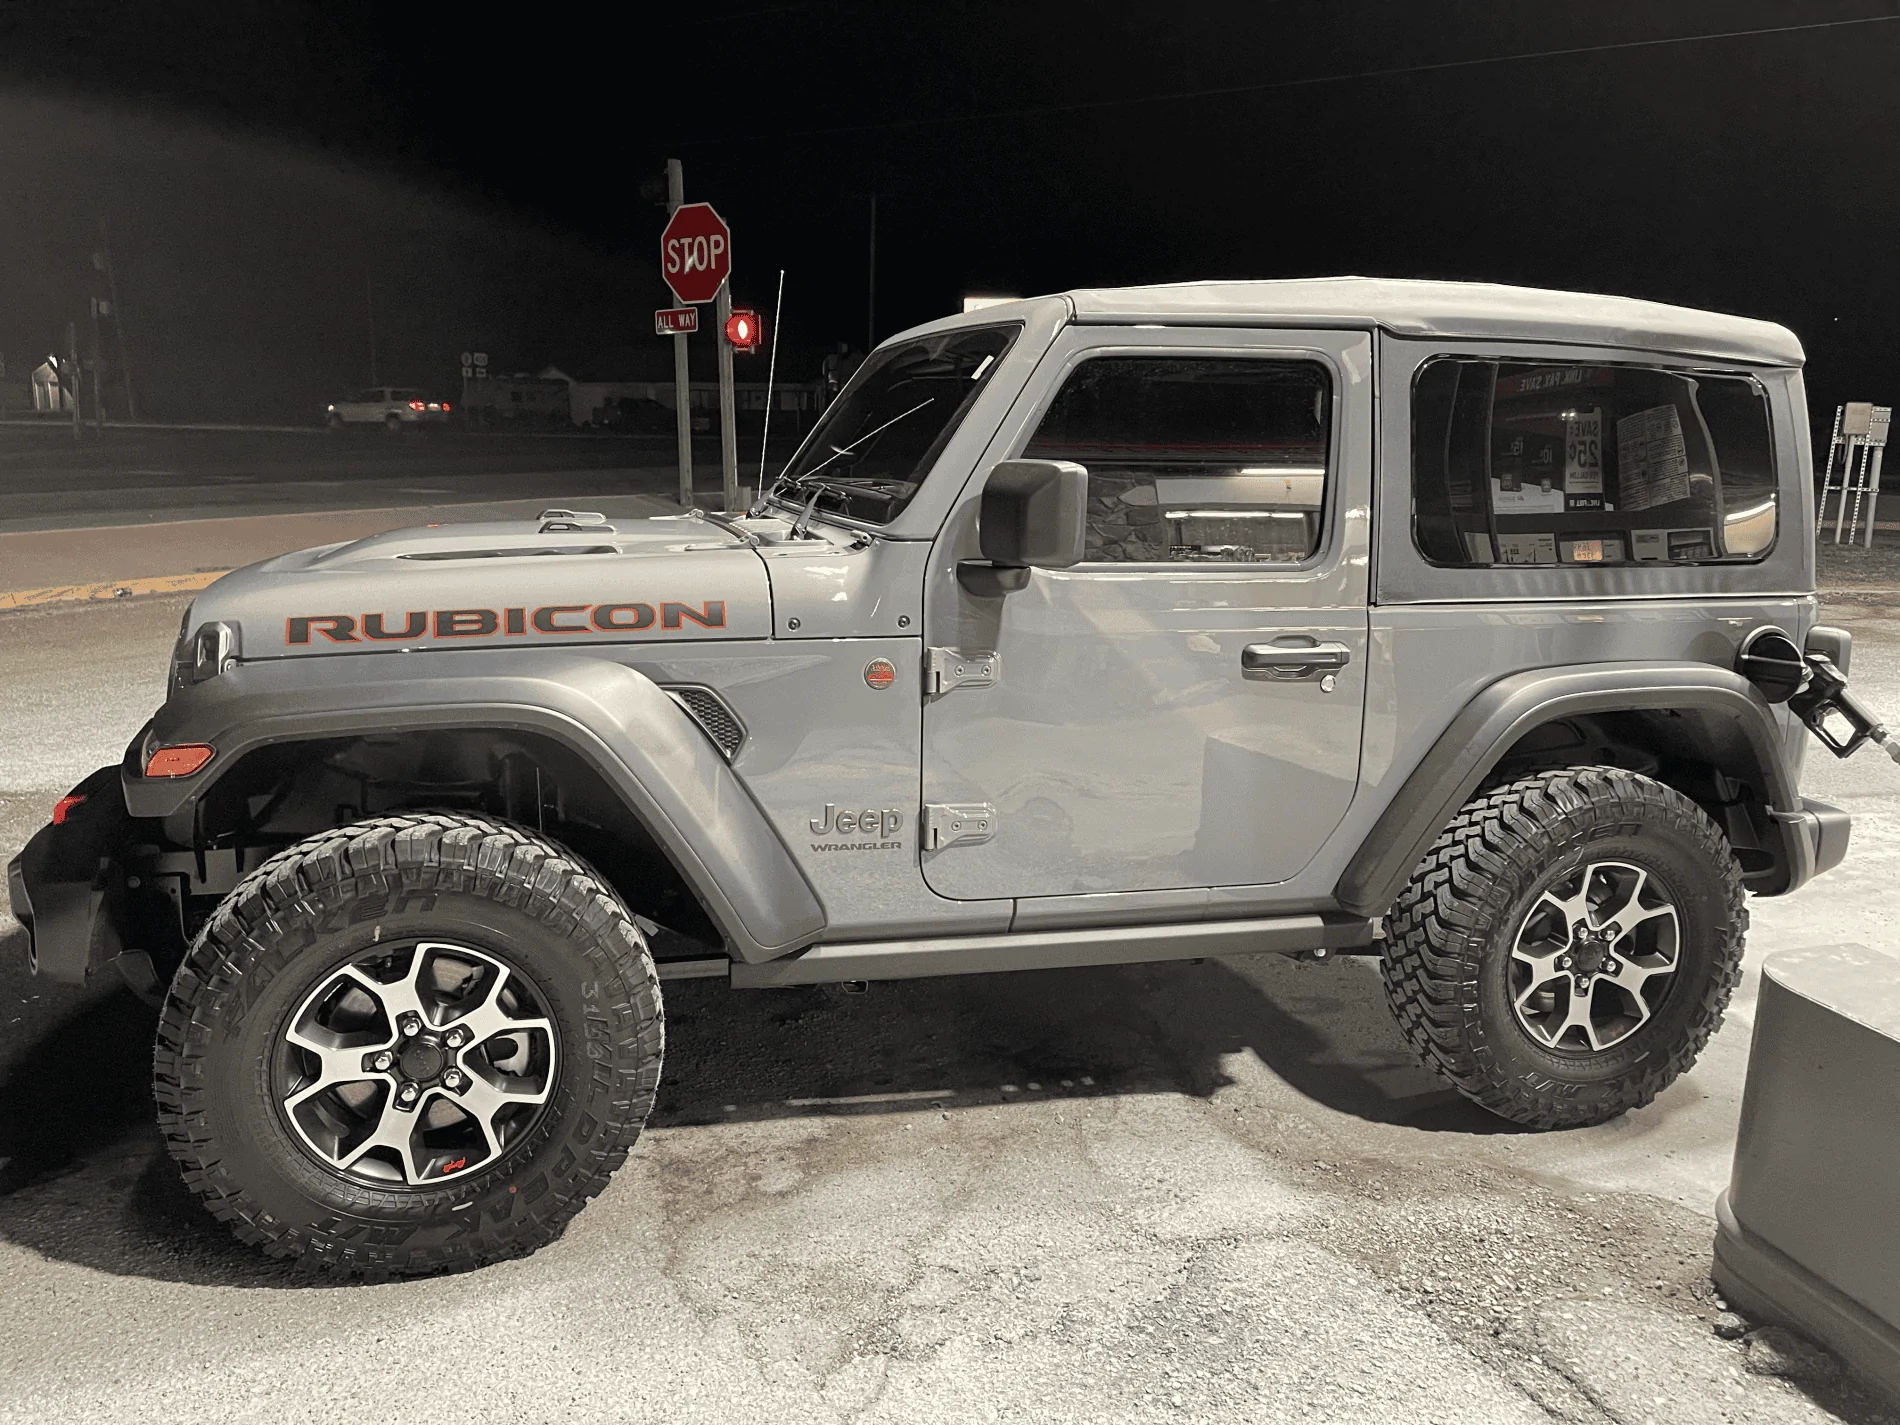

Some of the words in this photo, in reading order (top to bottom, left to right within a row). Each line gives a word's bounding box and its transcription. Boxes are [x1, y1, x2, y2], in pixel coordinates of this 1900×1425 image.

[667, 234, 725, 274] STOP
[657, 315, 674, 329] ALL
[678, 312, 696, 328] WAY
[285, 600, 727, 646] RUBICON
[809, 803, 904, 839] Jeep
[810, 841, 902, 852] WRANGLER
